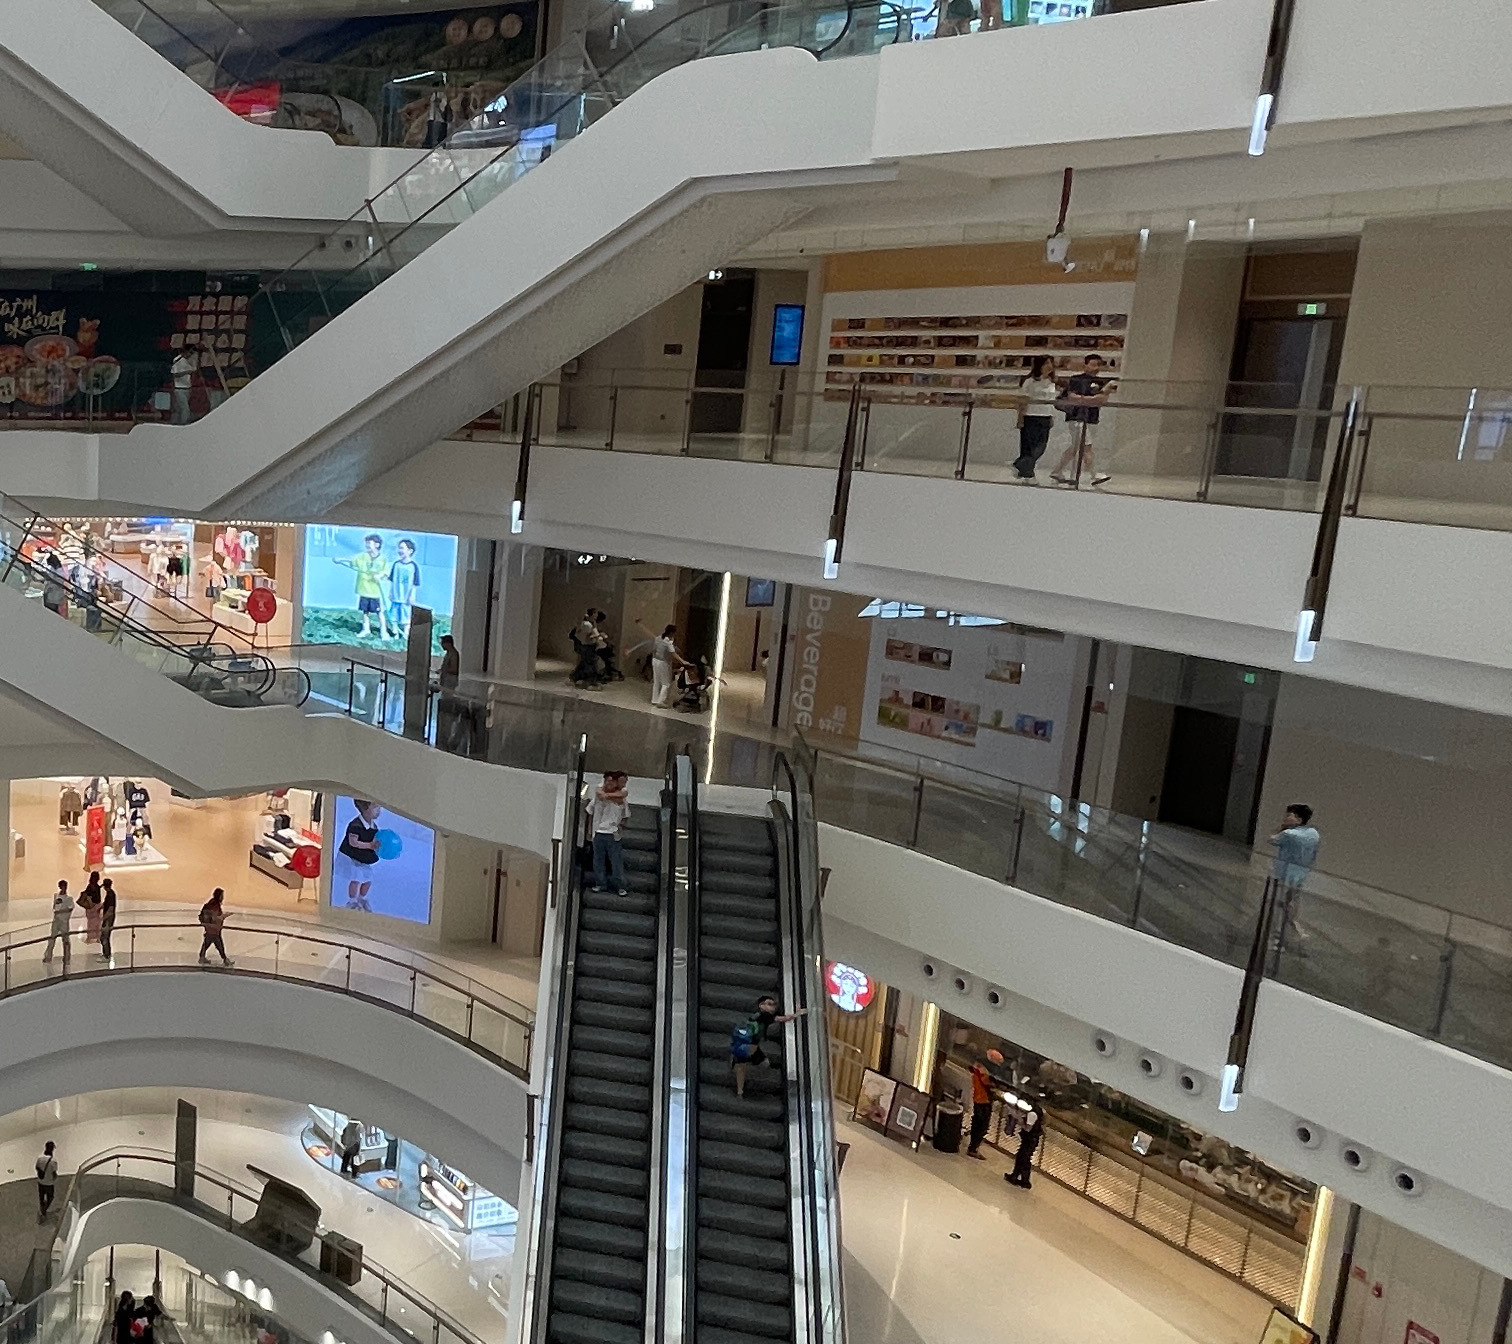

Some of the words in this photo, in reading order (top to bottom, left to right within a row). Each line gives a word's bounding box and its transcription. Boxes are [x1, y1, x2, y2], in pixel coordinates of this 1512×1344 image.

[5, 309, 67, 339] 味在向群
[793, 593, 831, 729] Beverage
